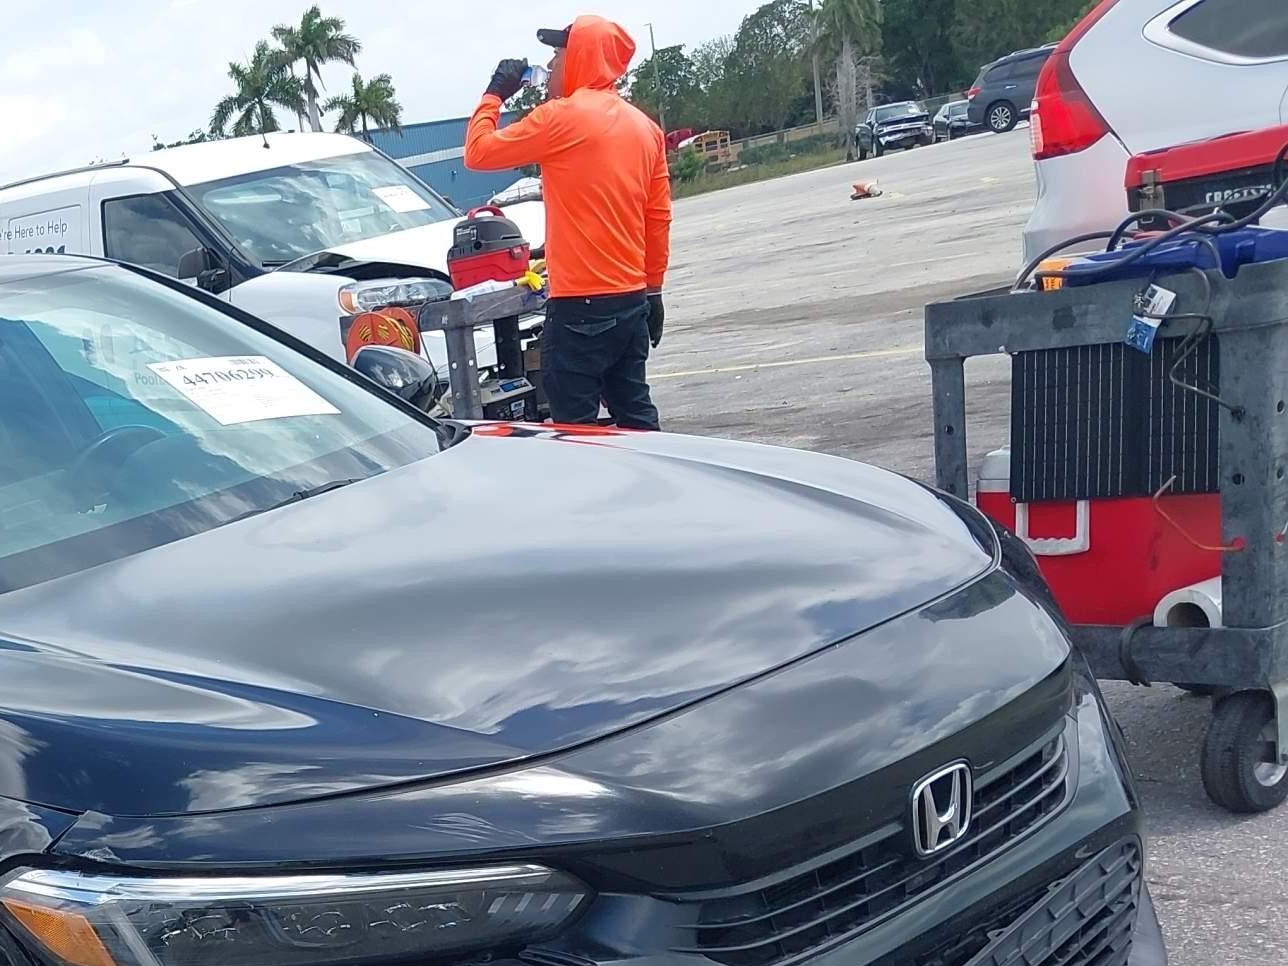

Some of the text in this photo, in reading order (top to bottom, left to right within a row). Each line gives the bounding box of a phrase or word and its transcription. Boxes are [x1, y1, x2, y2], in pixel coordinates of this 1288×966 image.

[14, 225, 34, 239] Here
[36, 224, 45, 236] to
[47, 217, 68, 238] Help
[183, 367, 274, 387] 44706299
